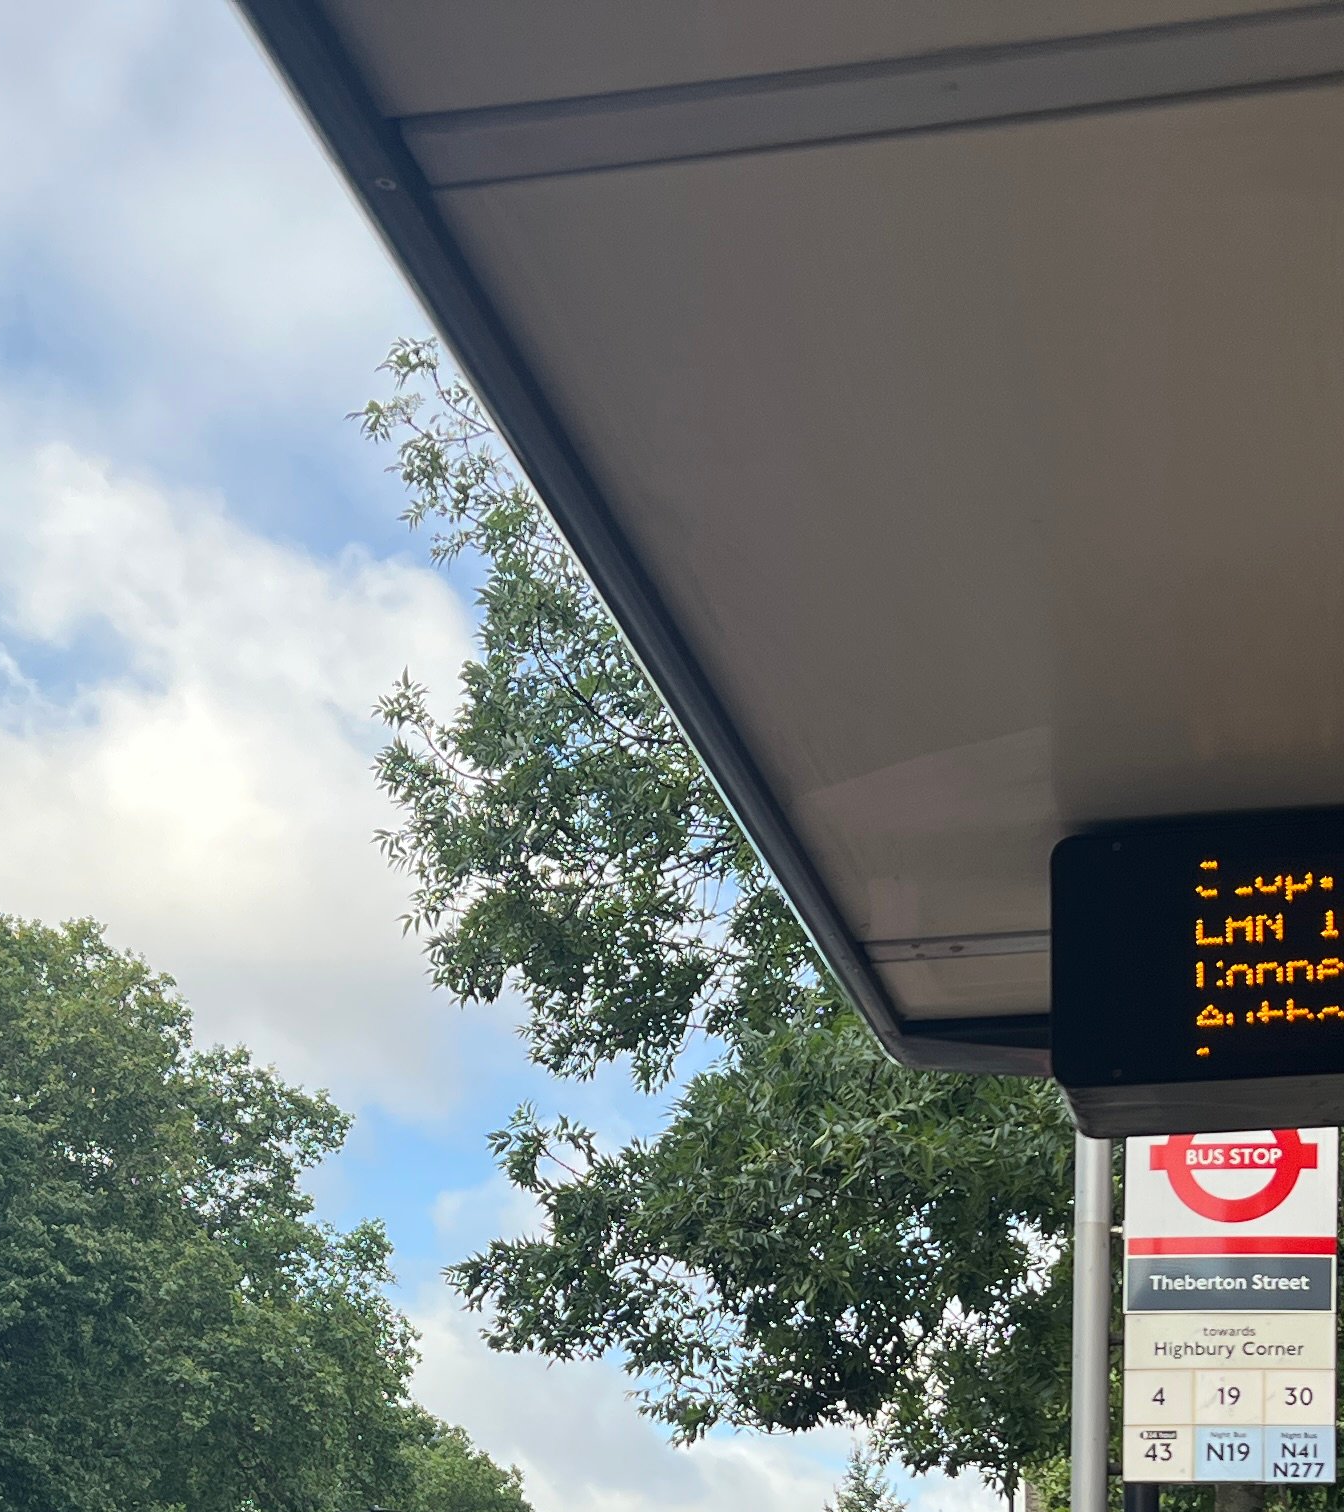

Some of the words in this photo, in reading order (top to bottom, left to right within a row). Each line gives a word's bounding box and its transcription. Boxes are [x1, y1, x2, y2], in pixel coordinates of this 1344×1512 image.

[1186, 1149, 1224, 1166] BUS
[1229, 1148, 1283, 1165] STOP
[1150, 1274, 1247, 1291] Theberton
[1252, 1274, 1310, 1290] Street
[1203, 1326, 1256, 1337] towards
[1155, 1341, 1235, 1359] Highbury
[1243, 1341, 1304, 1356] Corner
[1152, 1387, 1166, 1405] 4
[1217, 1387, 1241, 1405] 19
[1285, 1387, 1313, 1406] 30
[1144, 1443, 1173, 1461] 43
[1207, 1443, 1250, 1461] N19
[1281, 1443, 1317, 1458] N41
[1273, 1462, 1325, 1478] N277
